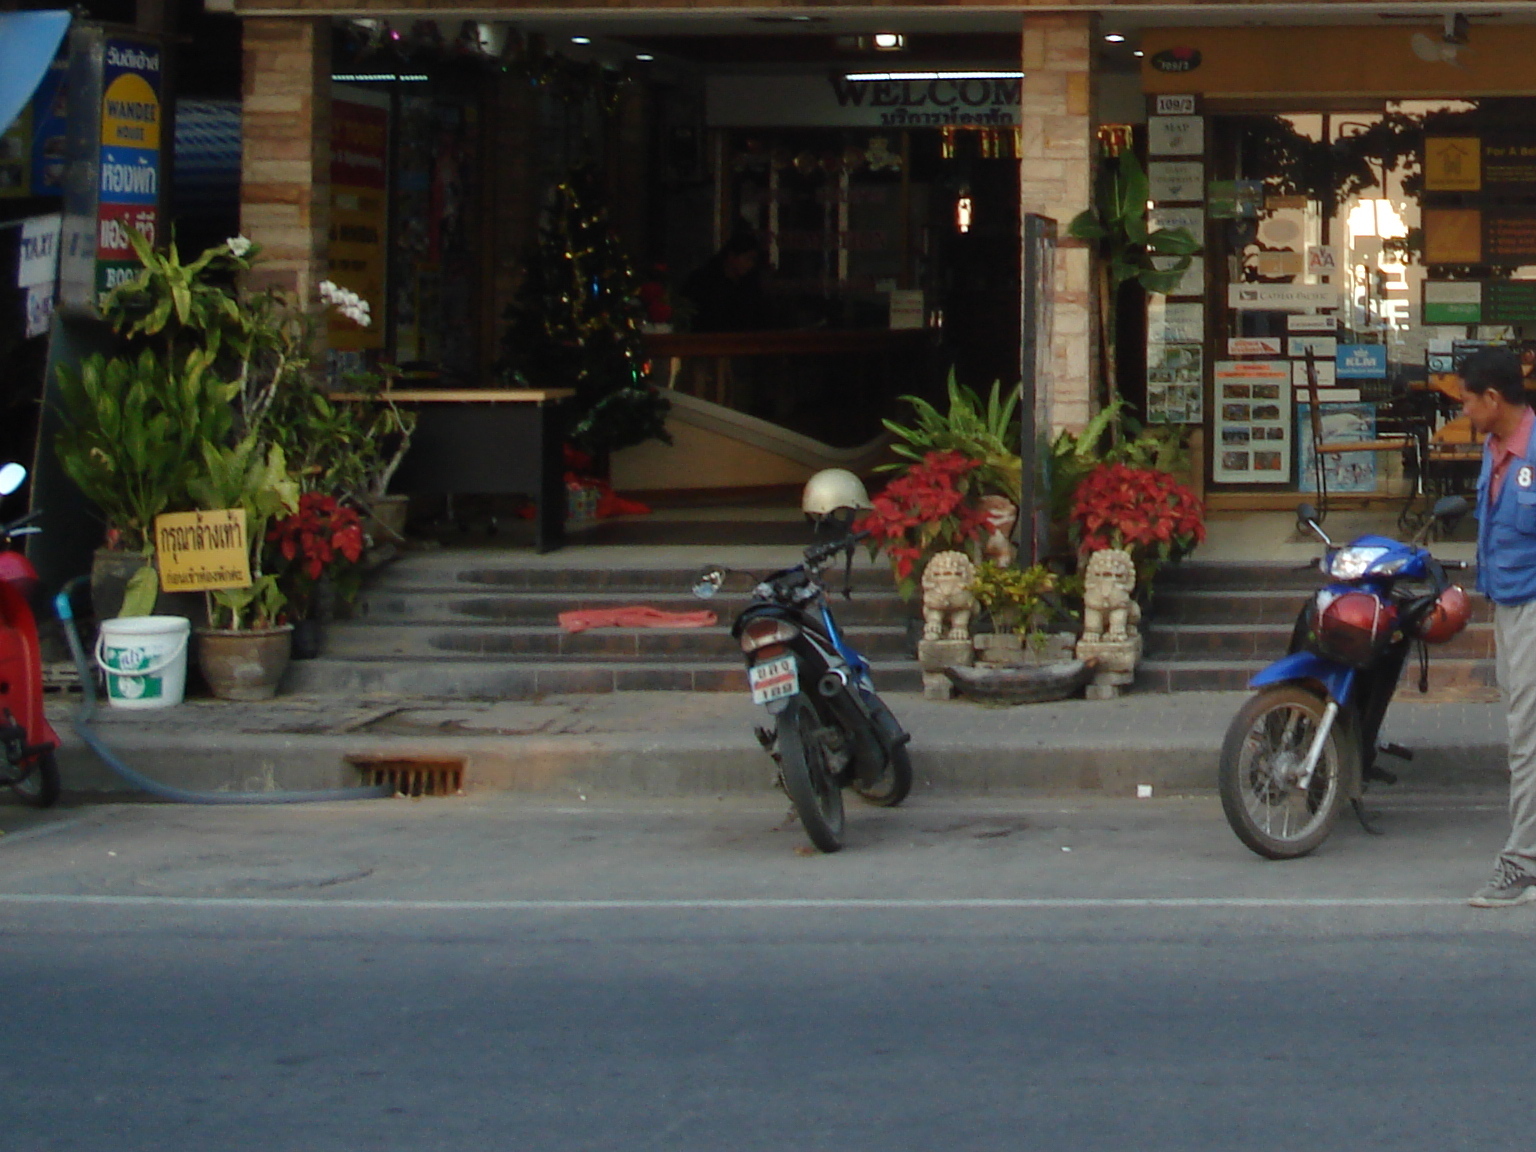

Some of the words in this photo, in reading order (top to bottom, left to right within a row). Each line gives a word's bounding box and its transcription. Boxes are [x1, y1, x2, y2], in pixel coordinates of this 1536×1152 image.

[106, 99, 156, 123] WANDEE
[1160, 99, 1193, 111] 109/2
[102, 154, 156, 193] ห้องพัก
[22, 231, 54, 261] TAXI
[1345, 357, 1378, 367] KLM
[1517, 466, 1532, 488] 8
